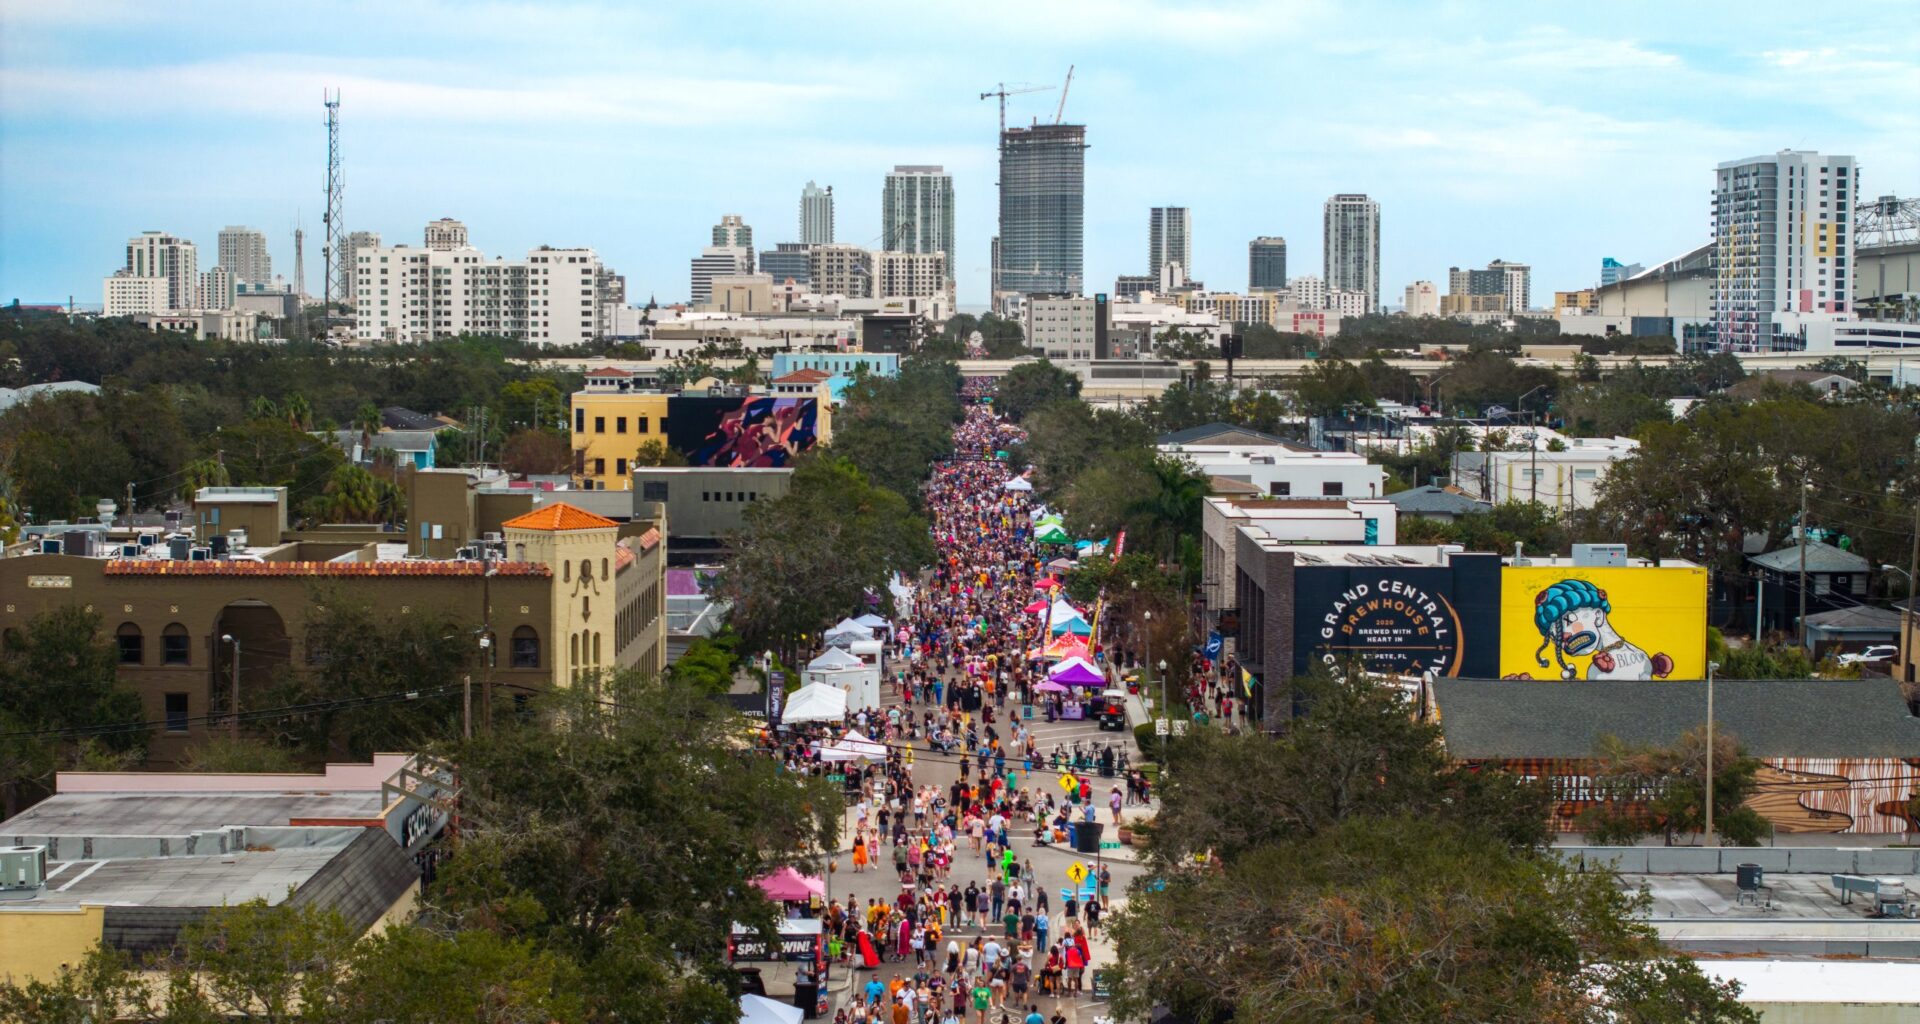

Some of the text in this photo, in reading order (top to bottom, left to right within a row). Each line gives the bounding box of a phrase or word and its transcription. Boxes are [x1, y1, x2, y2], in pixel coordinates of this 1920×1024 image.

[1321, 579, 1448, 640] GRAND CENTRAL
[1341, 598, 1429, 636] BREWHOUSE
[780, 940, 811, 954] WIN!
